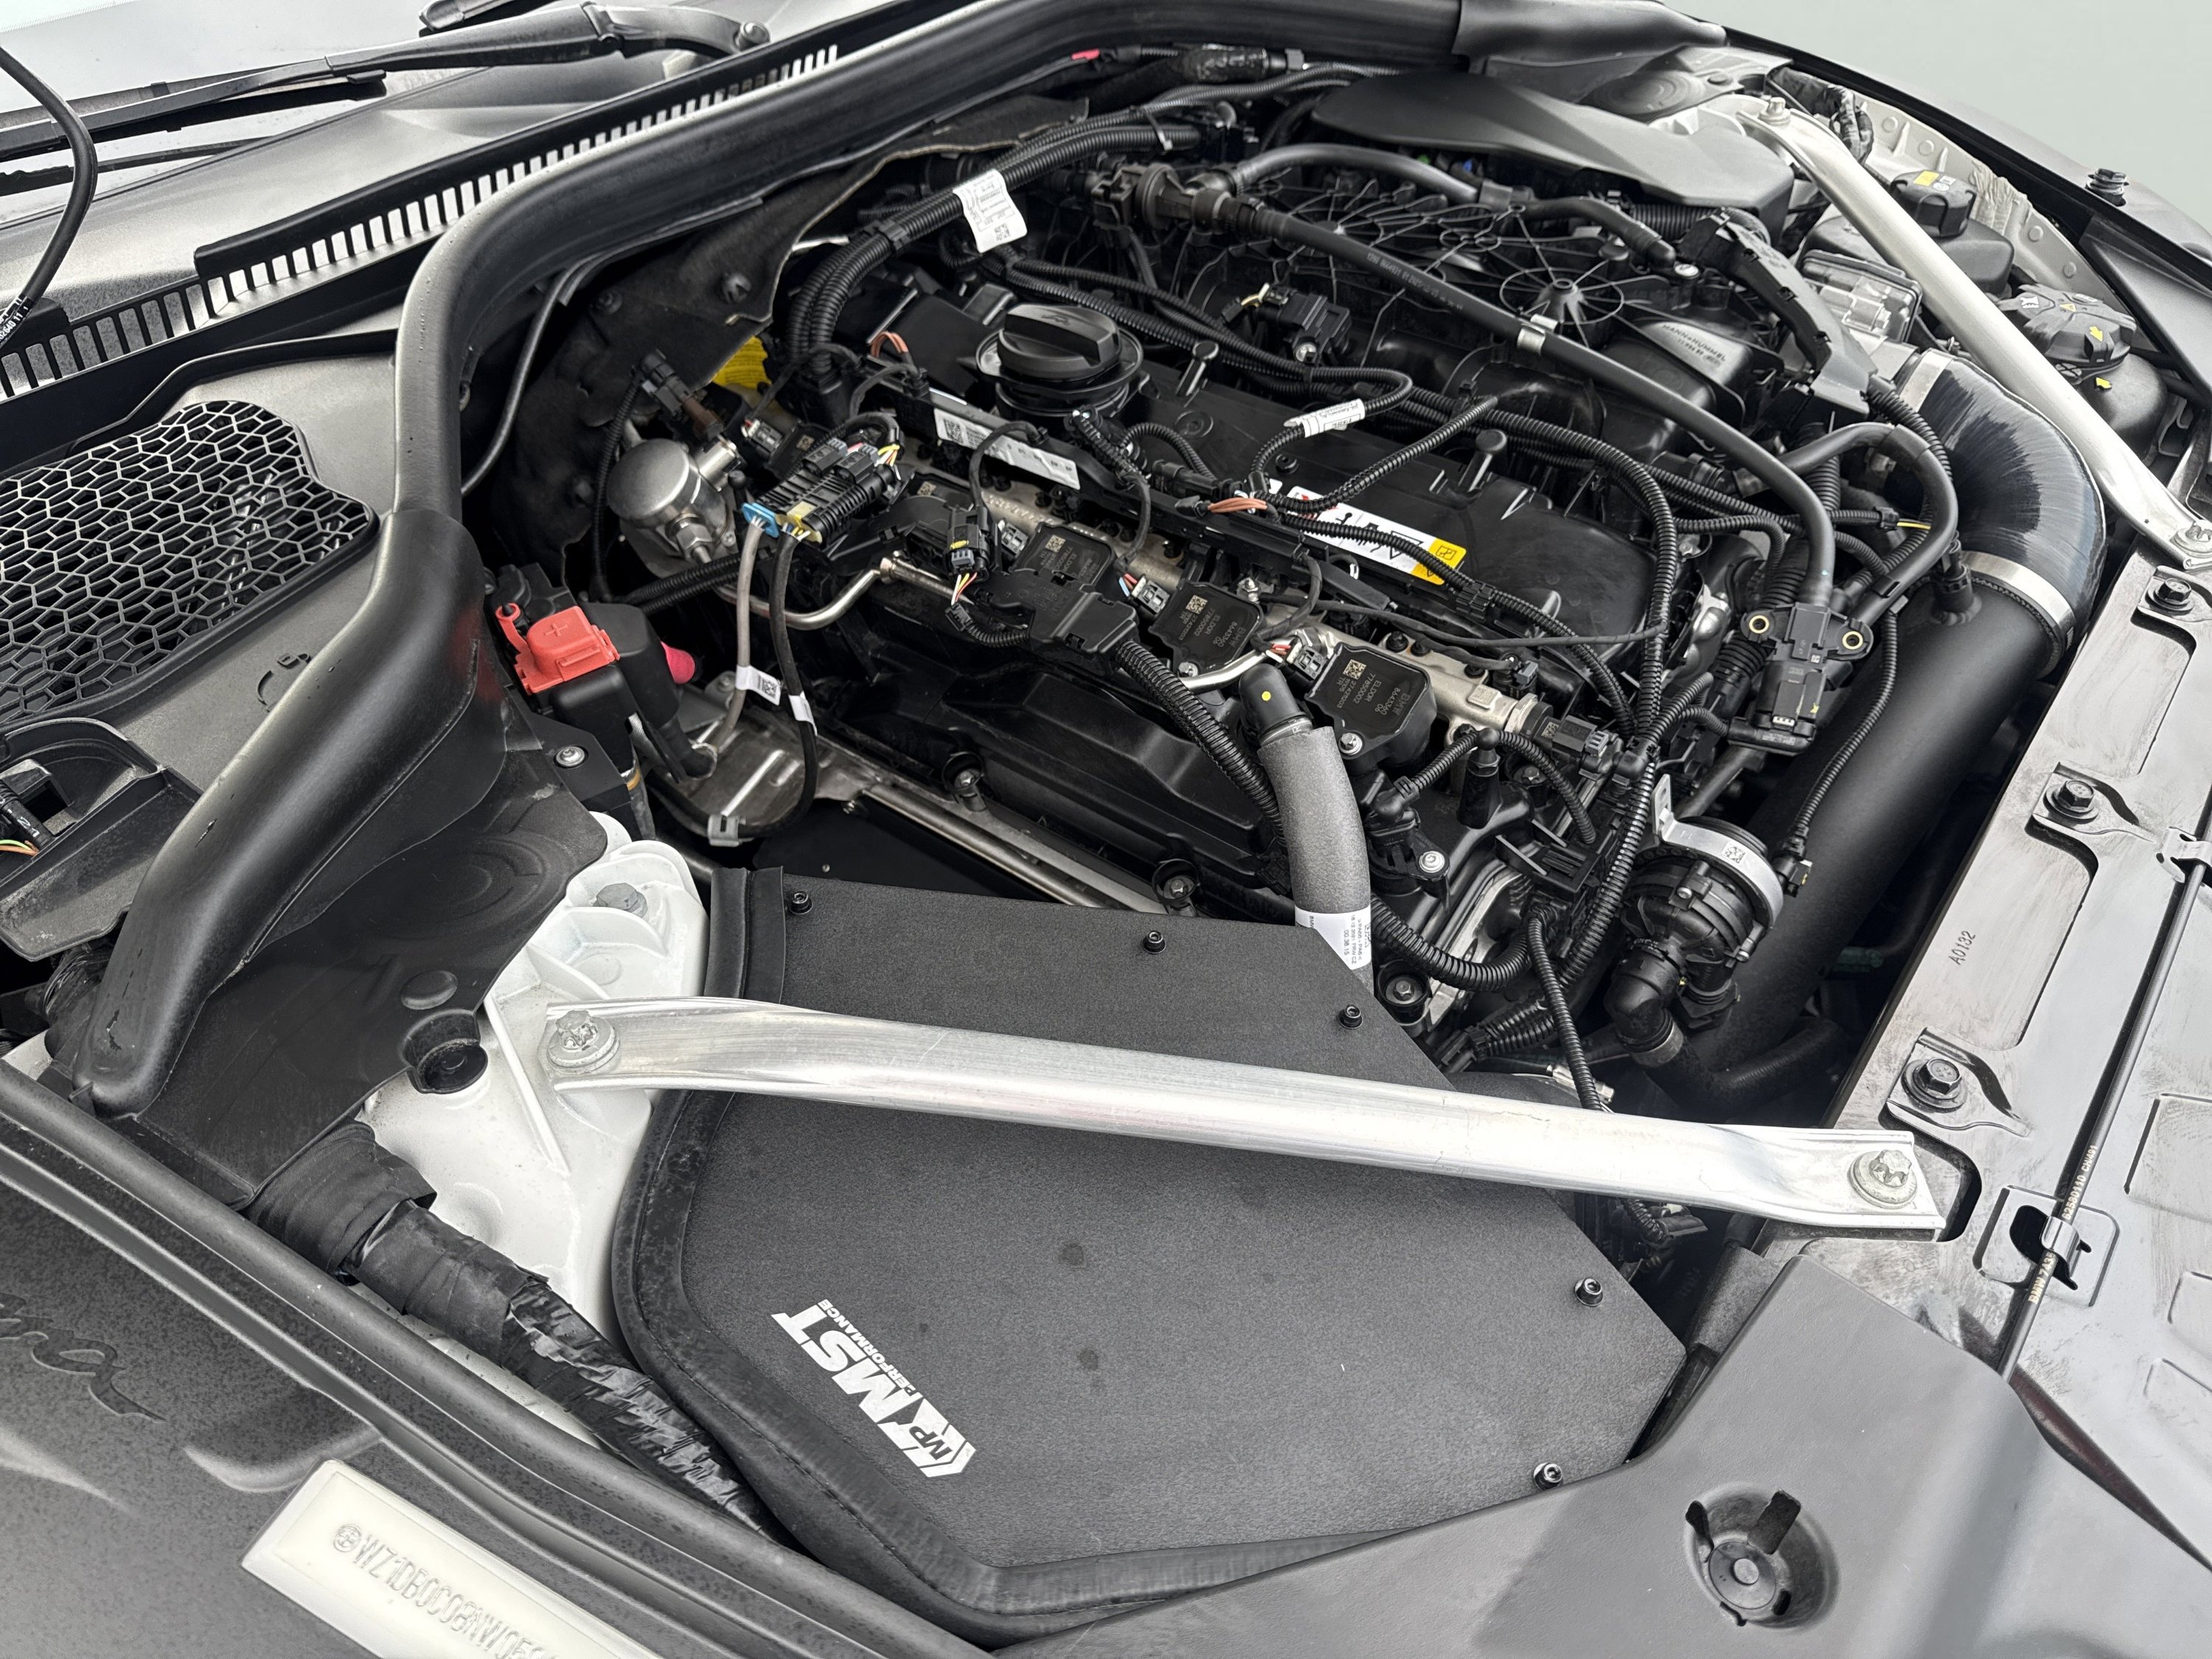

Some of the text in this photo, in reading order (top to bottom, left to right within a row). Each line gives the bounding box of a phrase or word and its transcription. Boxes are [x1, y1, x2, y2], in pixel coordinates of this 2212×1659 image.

[1203, 613, 1221, 636] ELDOR
[1335, 675, 1346, 686] TR
[1352, 671, 1376, 704] 77850002
[1364, 679, 1382, 703] ELDOR
[1373, 702, 1384, 714] 06
[1379, 686, 1401, 716] 8643360
[1391, 692, 1411, 717] BMW
[1947, 928, 1976, 967] A0132
[2027, 1275, 2046, 1304] BMW
[817, 1298, 917, 1397] PERFORMANCE
[771, 1304, 923, 1423] MST
